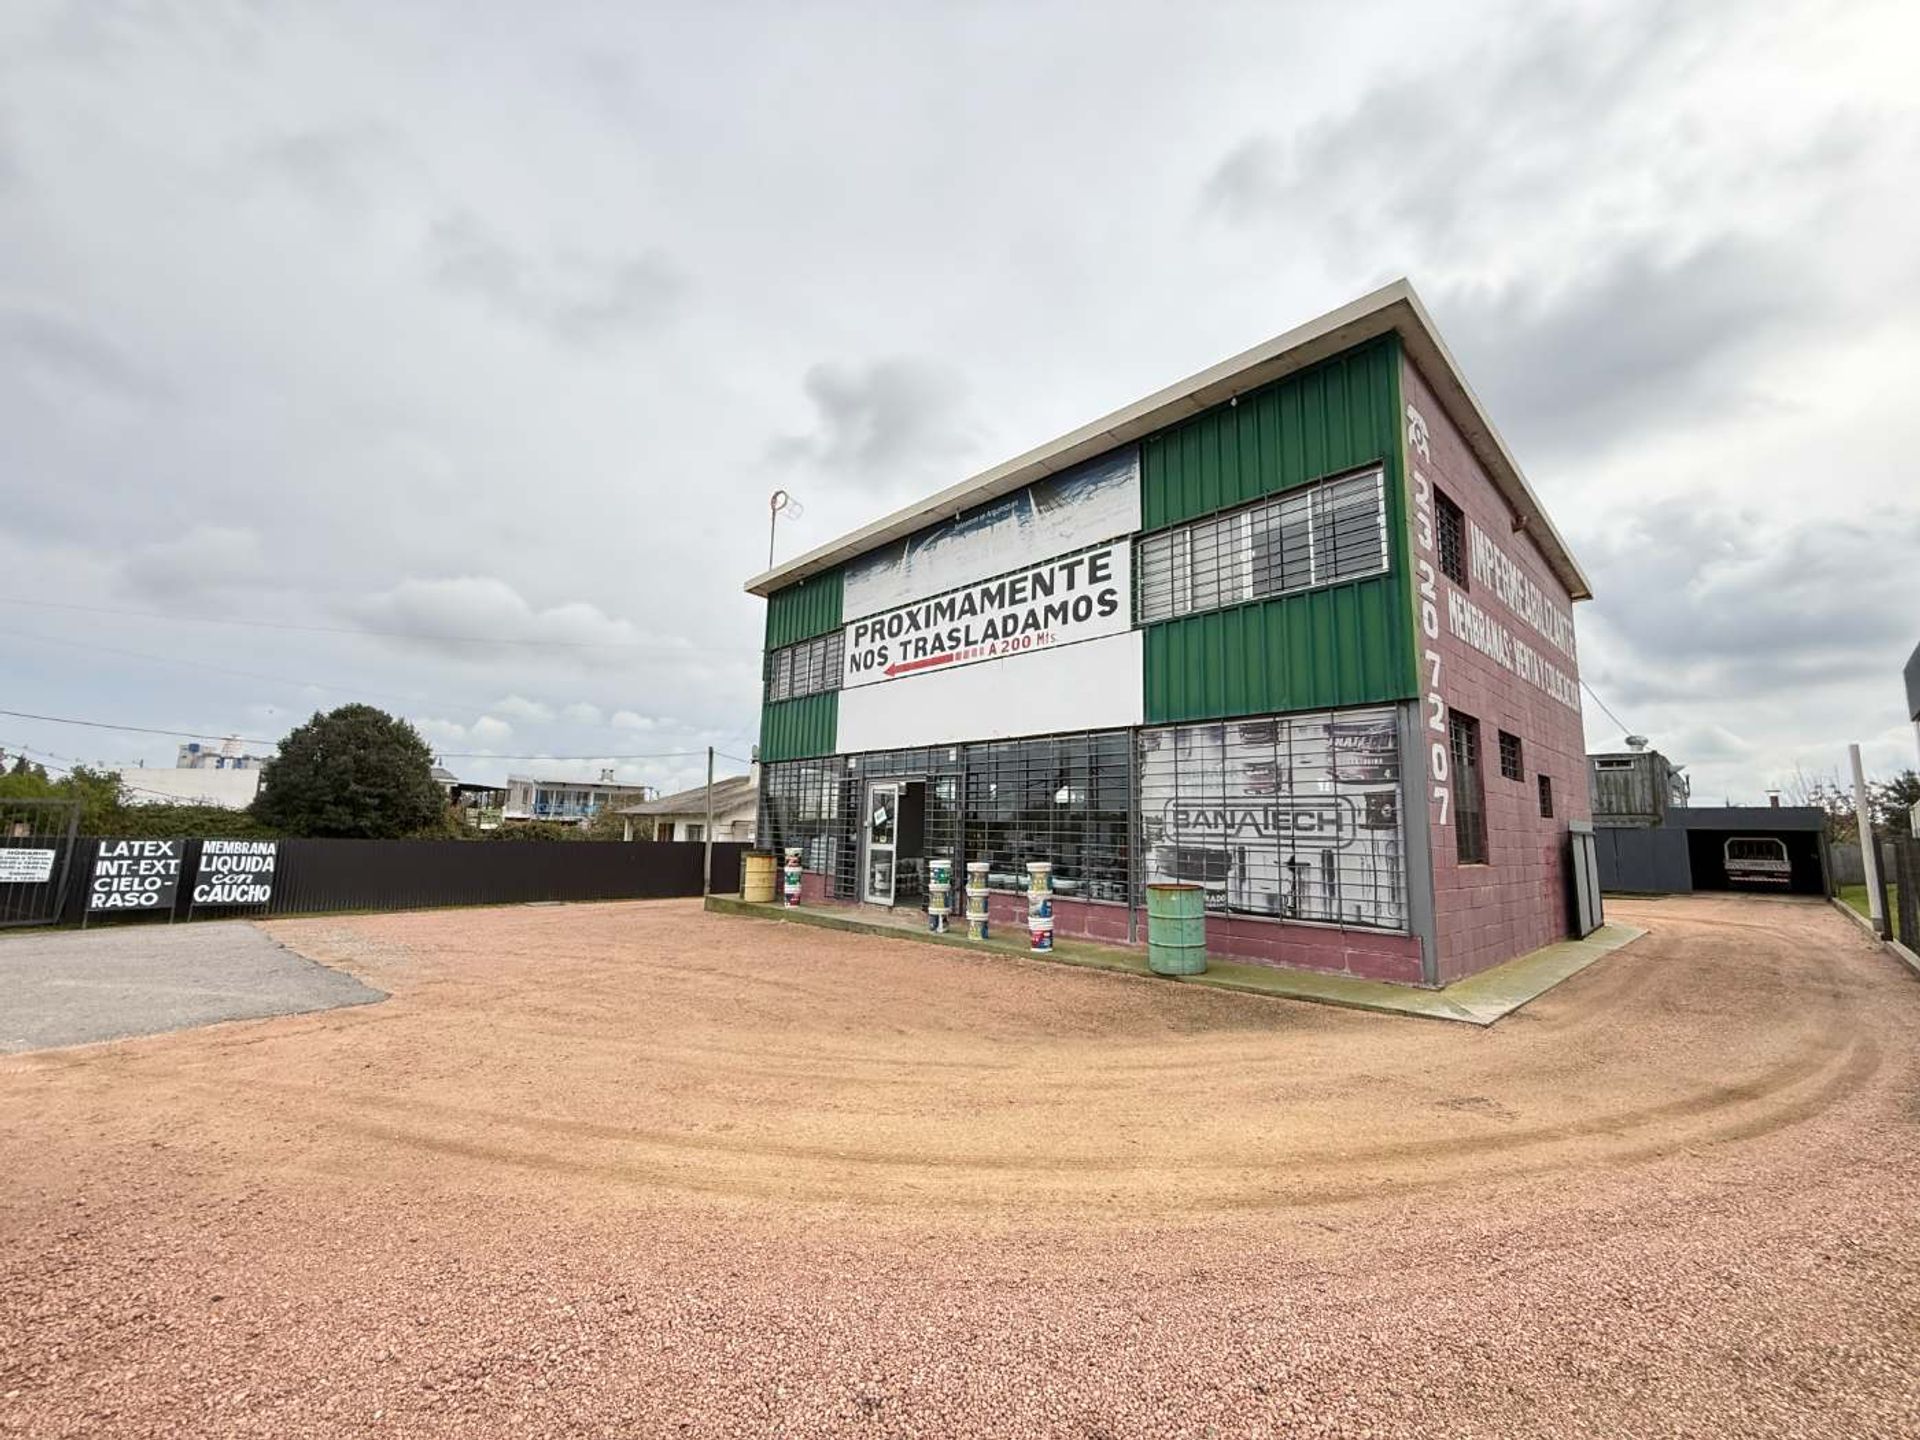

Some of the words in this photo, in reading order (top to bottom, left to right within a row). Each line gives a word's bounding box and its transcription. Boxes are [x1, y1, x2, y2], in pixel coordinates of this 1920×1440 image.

[854, 550, 1113, 649] PROXIMAMENTE
[850, 645, 889, 674] NOS
[900, 587, 1119, 662] TRASLADAMOS
[988, 642, 997, 656] A
[1001, 634, 1032, 654] 200
[1172, 803, 1344, 837] BANATECH
[99, 840, 174, 857] LATEX
[202, 840, 277, 855] MEMBRANA
[200, 856, 276, 874] LIQUIDA
[211, 873, 254, 885] con
[90, 892, 159, 908] RASO
[193, 884, 272, 903] CAUCHO
